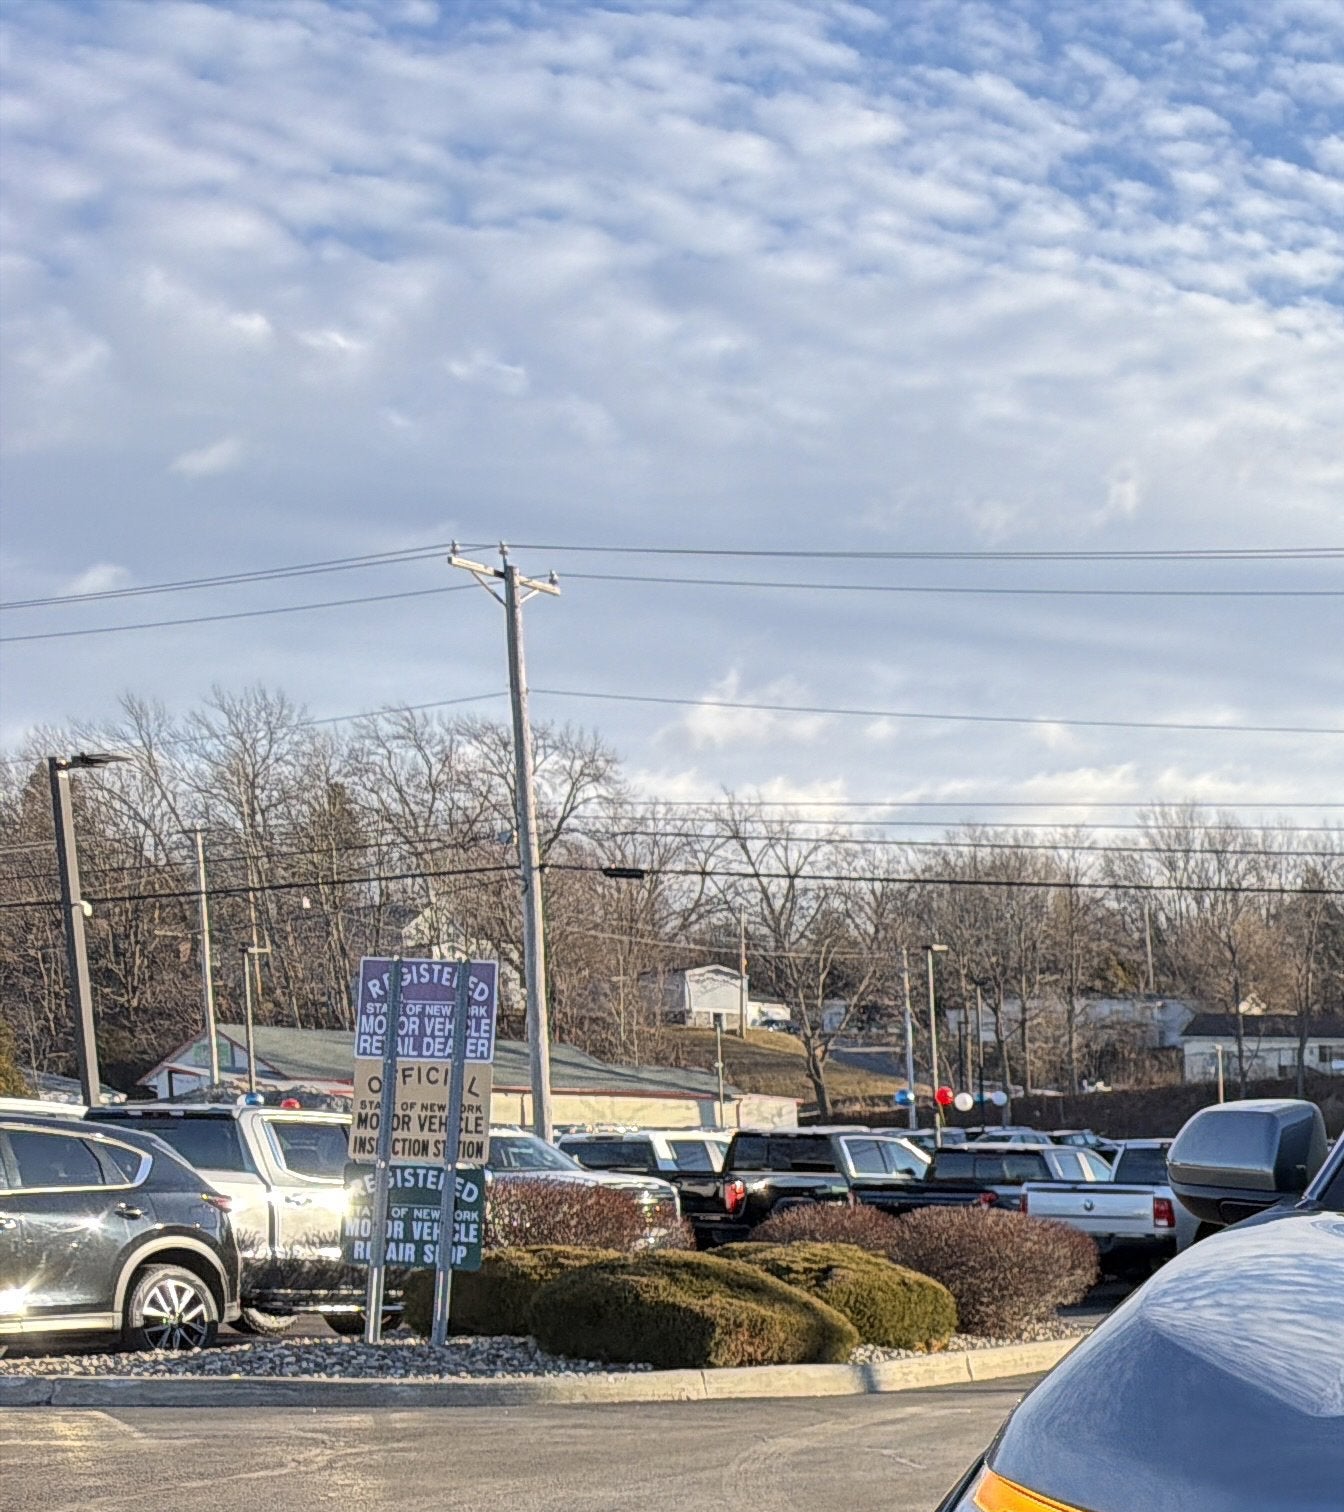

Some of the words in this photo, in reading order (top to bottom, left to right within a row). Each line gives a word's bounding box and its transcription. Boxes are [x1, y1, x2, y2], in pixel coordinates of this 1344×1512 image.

[367, 963, 489, 1002] RGISTEED
[366, 1002, 403, 1015] STA
[406, 1004, 423, 1016] OF
[425, 1004, 453, 1017] NEW
[467, 1005, 488, 1018] RK
[360, 1015, 420, 1036] MOOR
[424, 1016, 491, 1038] VEHLE
[358, 1034, 418, 1056] REAIL
[422, 1036, 489, 1059] DEAER
[367, 1066, 480, 1098] OFICIL
[359, 1099, 395, 1111] STA
[400, 1101, 417, 1112] OF
[420, 1102, 446, 1113] NEW
[460, 1103, 483, 1115] ORK
[356, 1112, 412, 1132] MOOR
[417, 1114, 484, 1134] VEHLE
[353, 1135, 429, 1157] INSCTION
[432, 1138, 484, 1160] STION
[351, 1168, 479, 1203] REISTEED
[391, 1206, 409, 1218] OF
[413, 1208, 441, 1220] NEW
[454, 1210, 480, 1222] ORK
[345, 1217, 404, 1239] MOR
[411, 1221, 478, 1243] VEHCLE
[353, 1240, 415, 1262] RAIR
[423, 1244, 467, 1265] SP
